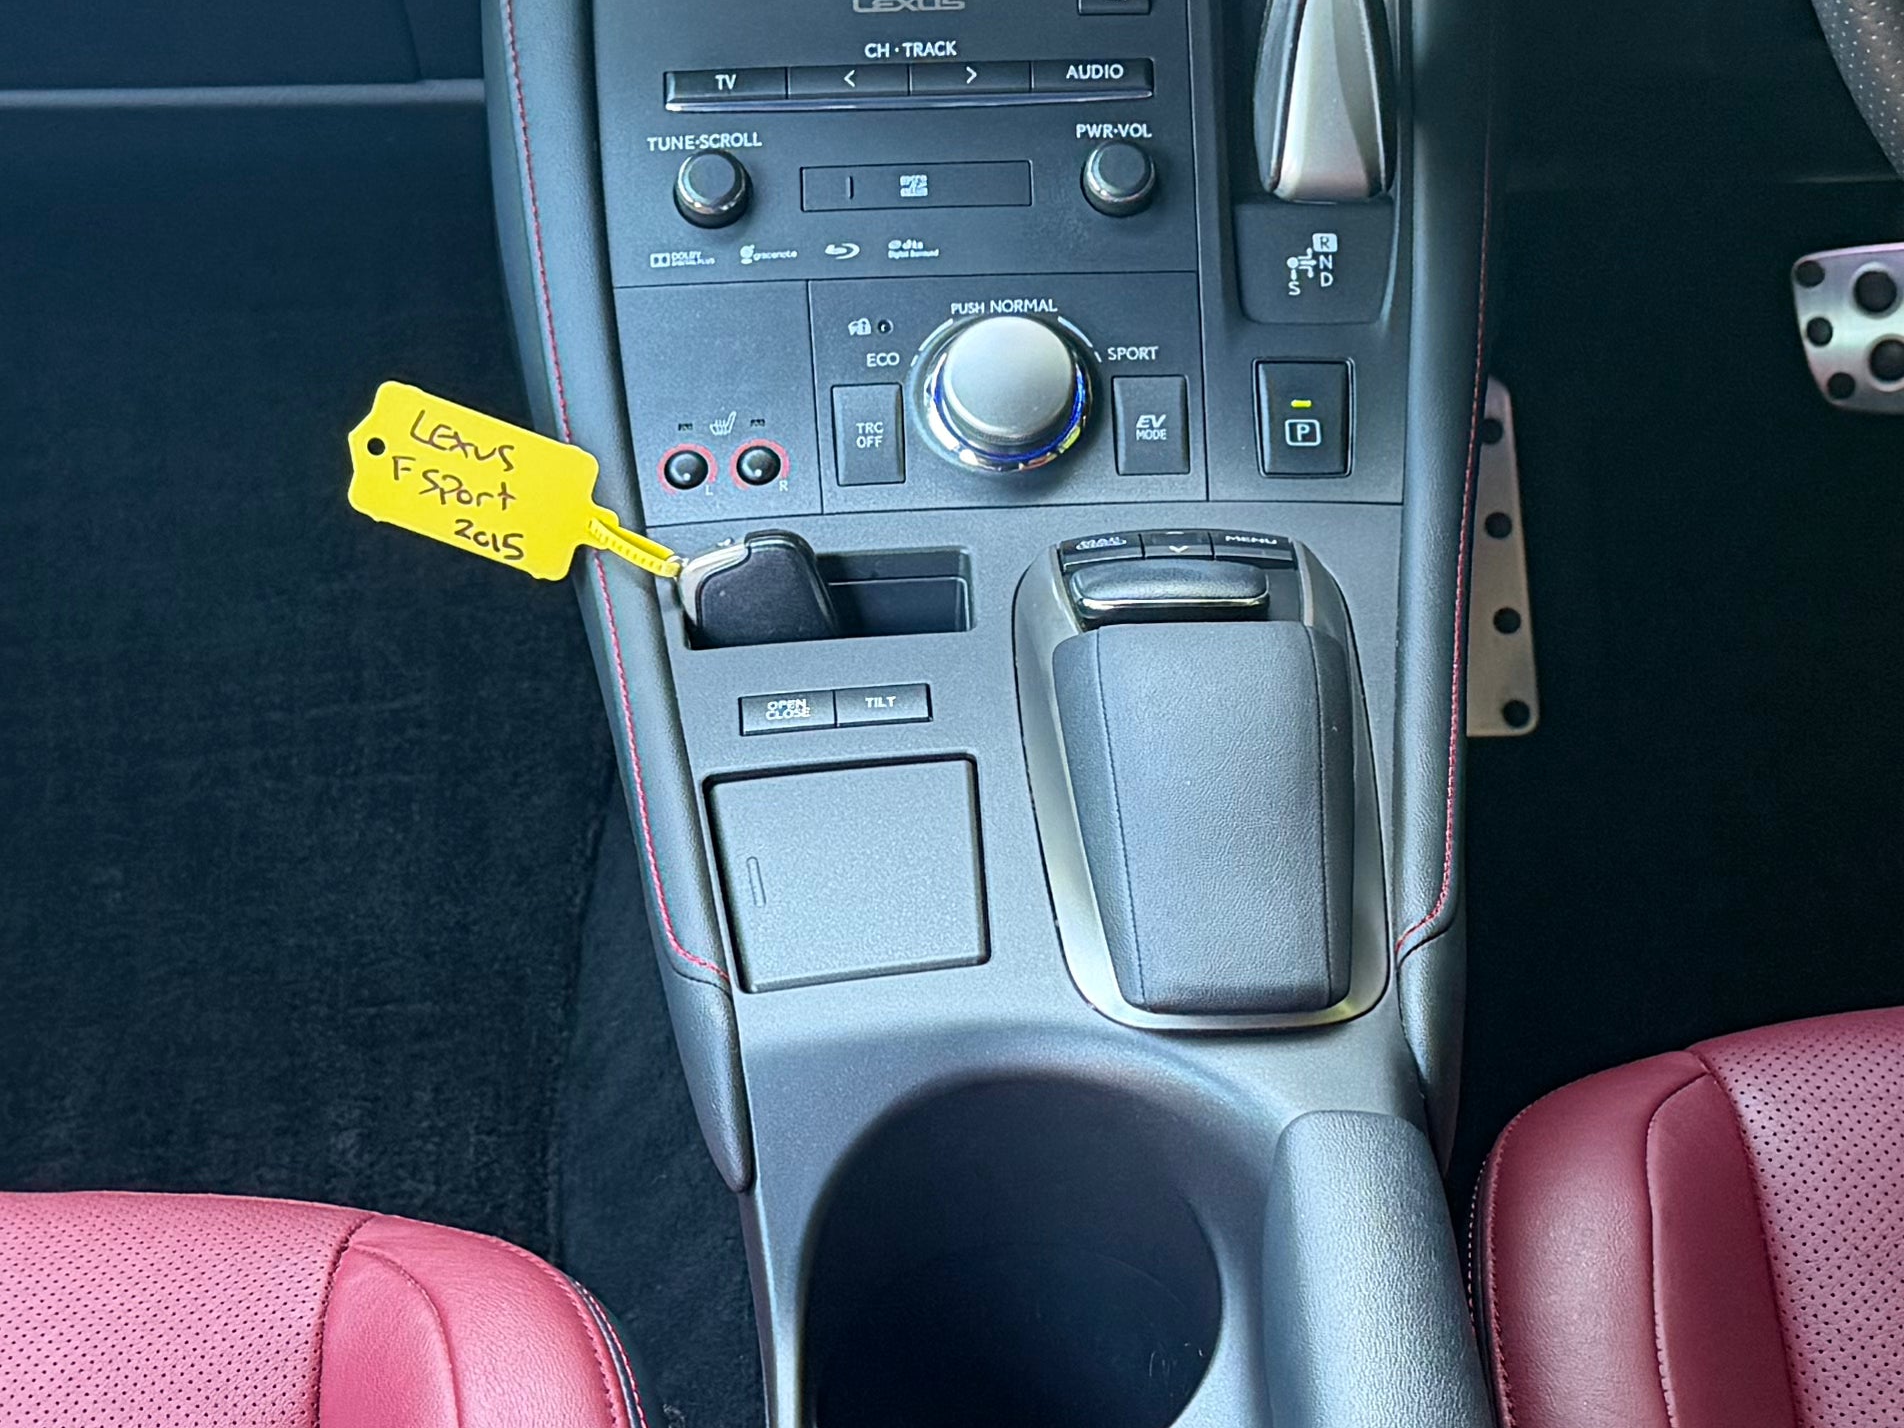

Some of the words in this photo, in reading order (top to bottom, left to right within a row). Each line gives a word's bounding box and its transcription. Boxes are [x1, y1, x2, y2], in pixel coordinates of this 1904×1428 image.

[1065, 63, 1125, 80] AUDIO
[715, 74, 736, 90] TV
[1318, 255, 1333, 271] N
[1320, 273, 1334, 287] D
[1288, 281, 1301, 296] S
[950, 300, 985, 316] PUSH
[989, 298, 1058, 314] NORMAL
[866, 352, 900, 368] ECO
[1107, 346, 1159, 362] SPORT
[856, 422, 884, 435] TRC
[1136, 414, 1167, 429] EV
[1136, 429, 1167, 441] MODE
[1296, 423, 1310, 442] P
[856, 435, 883, 449] OFF
[392, 455, 416, 481] F
[705, 484, 714, 496] L
[779, 480, 789, 492] R
[454, 518, 524, 561] 2015
[1224, 534, 1278, 546] MENU
[767, 698, 807, 712] OPEN
[865, 696, 897, 709] TILT
[765, 707, 811, 721] CLOSE
